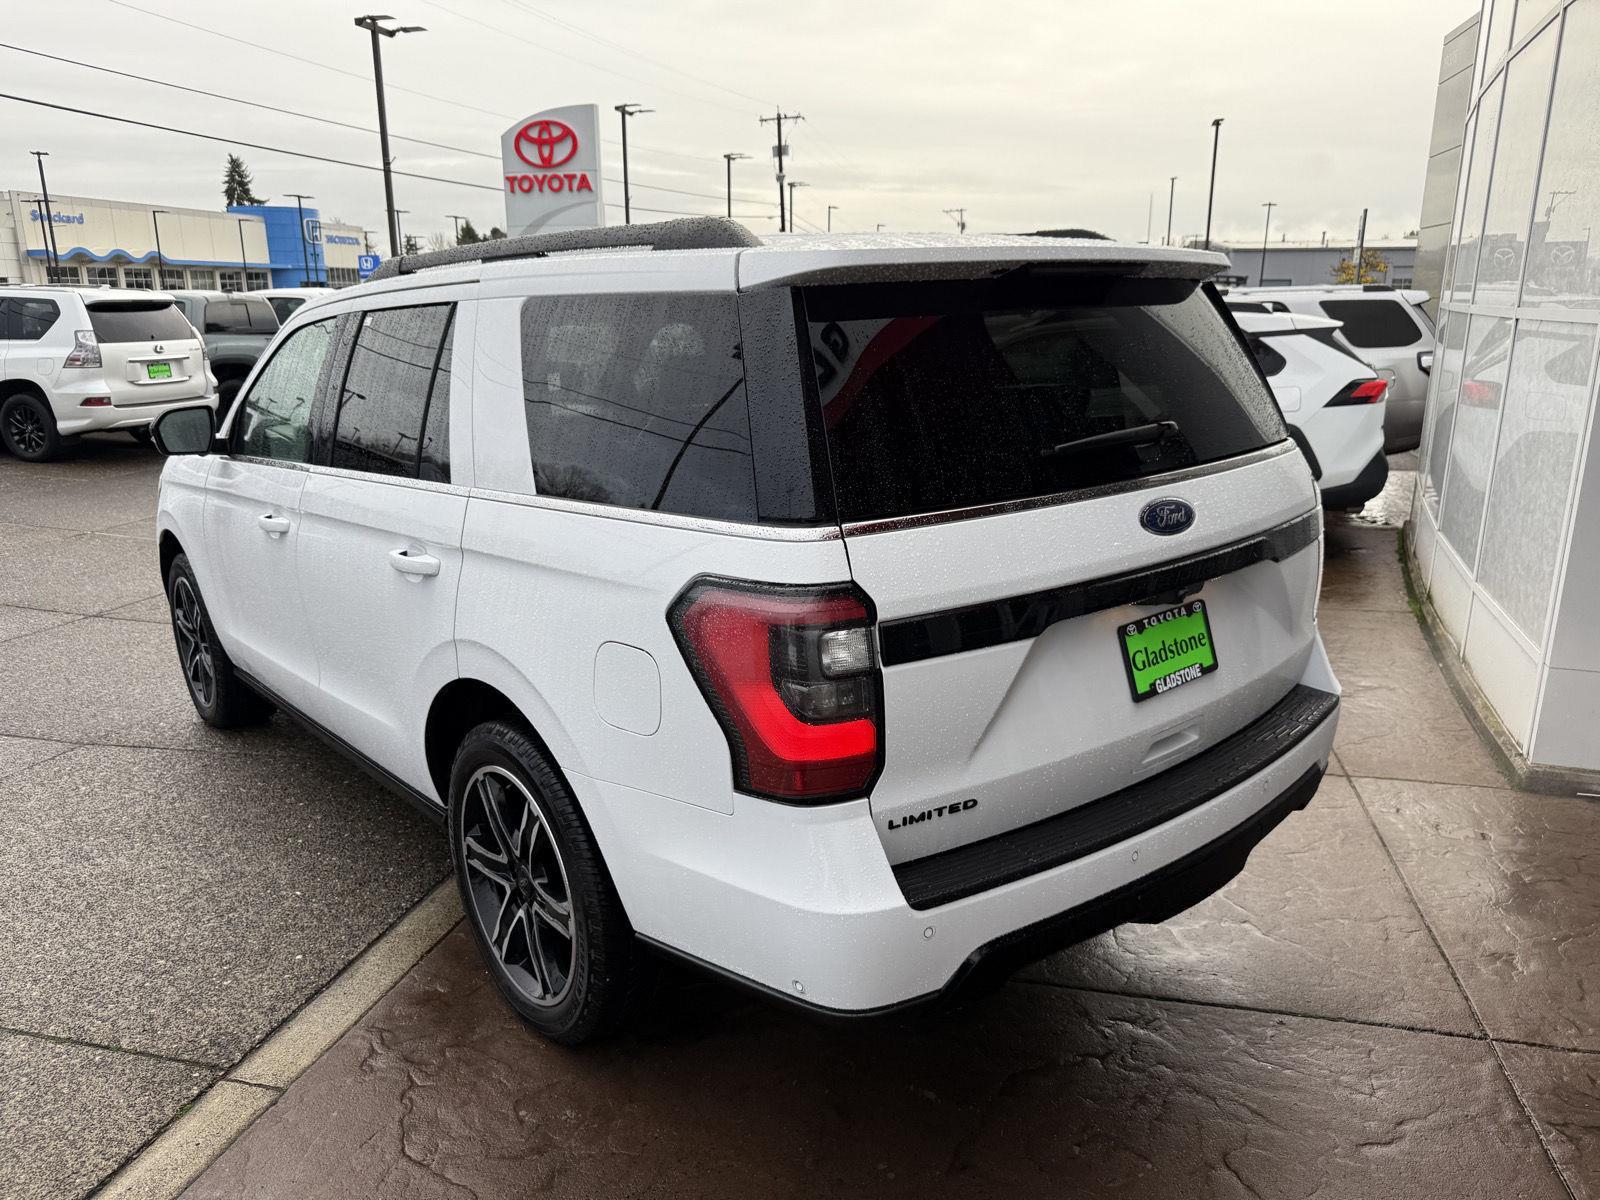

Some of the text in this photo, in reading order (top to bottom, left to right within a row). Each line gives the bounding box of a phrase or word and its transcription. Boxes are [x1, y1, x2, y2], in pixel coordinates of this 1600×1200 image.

[505, 173, 593, 194] TOYOTA
[1156, 504, 1187, 528] Ford
[1143, 607, 1187, 628] TOYOTA
[1131, 632, 1207, 672] Gladstone
[1155, 663, 1202, 694] GLADSTONE
[888, 798, 978, 830] LIMITED
